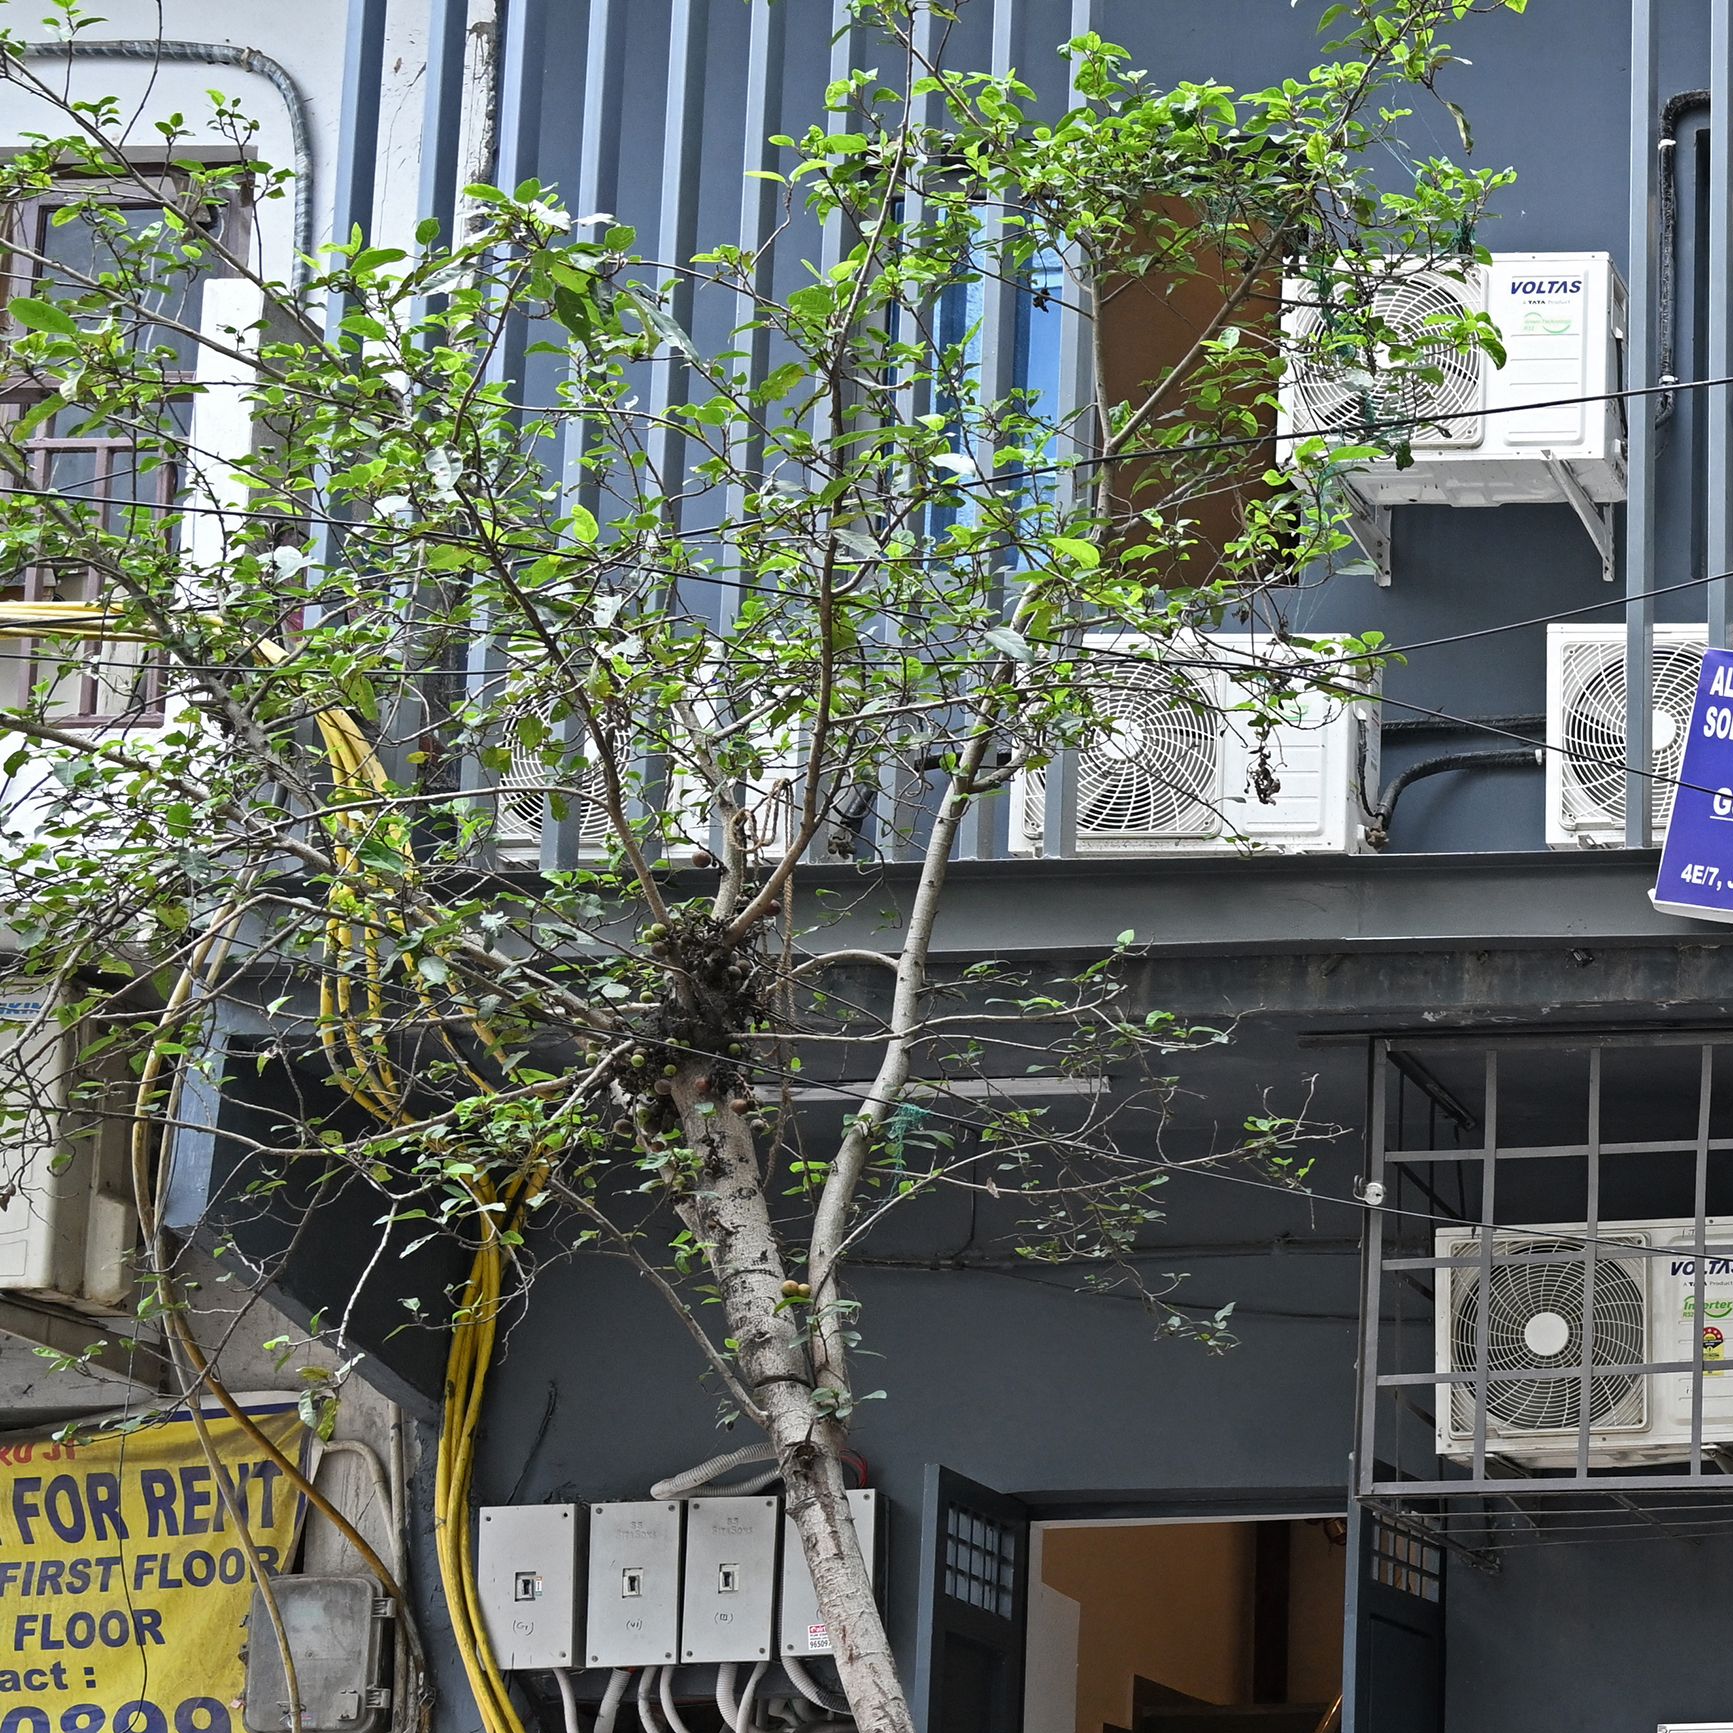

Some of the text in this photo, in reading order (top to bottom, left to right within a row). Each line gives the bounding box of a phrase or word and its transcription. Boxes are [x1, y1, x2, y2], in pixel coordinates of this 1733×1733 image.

[1511, 280, 1582, 295] VOLTAS
[1680, 862, 1723, 891] 4E/7,
[13, 1460, 283, 1545] FOR RENT
[133, 1546, 281, 1591] FLOOR
[14, 1609, 166, 1652] FLOOR
